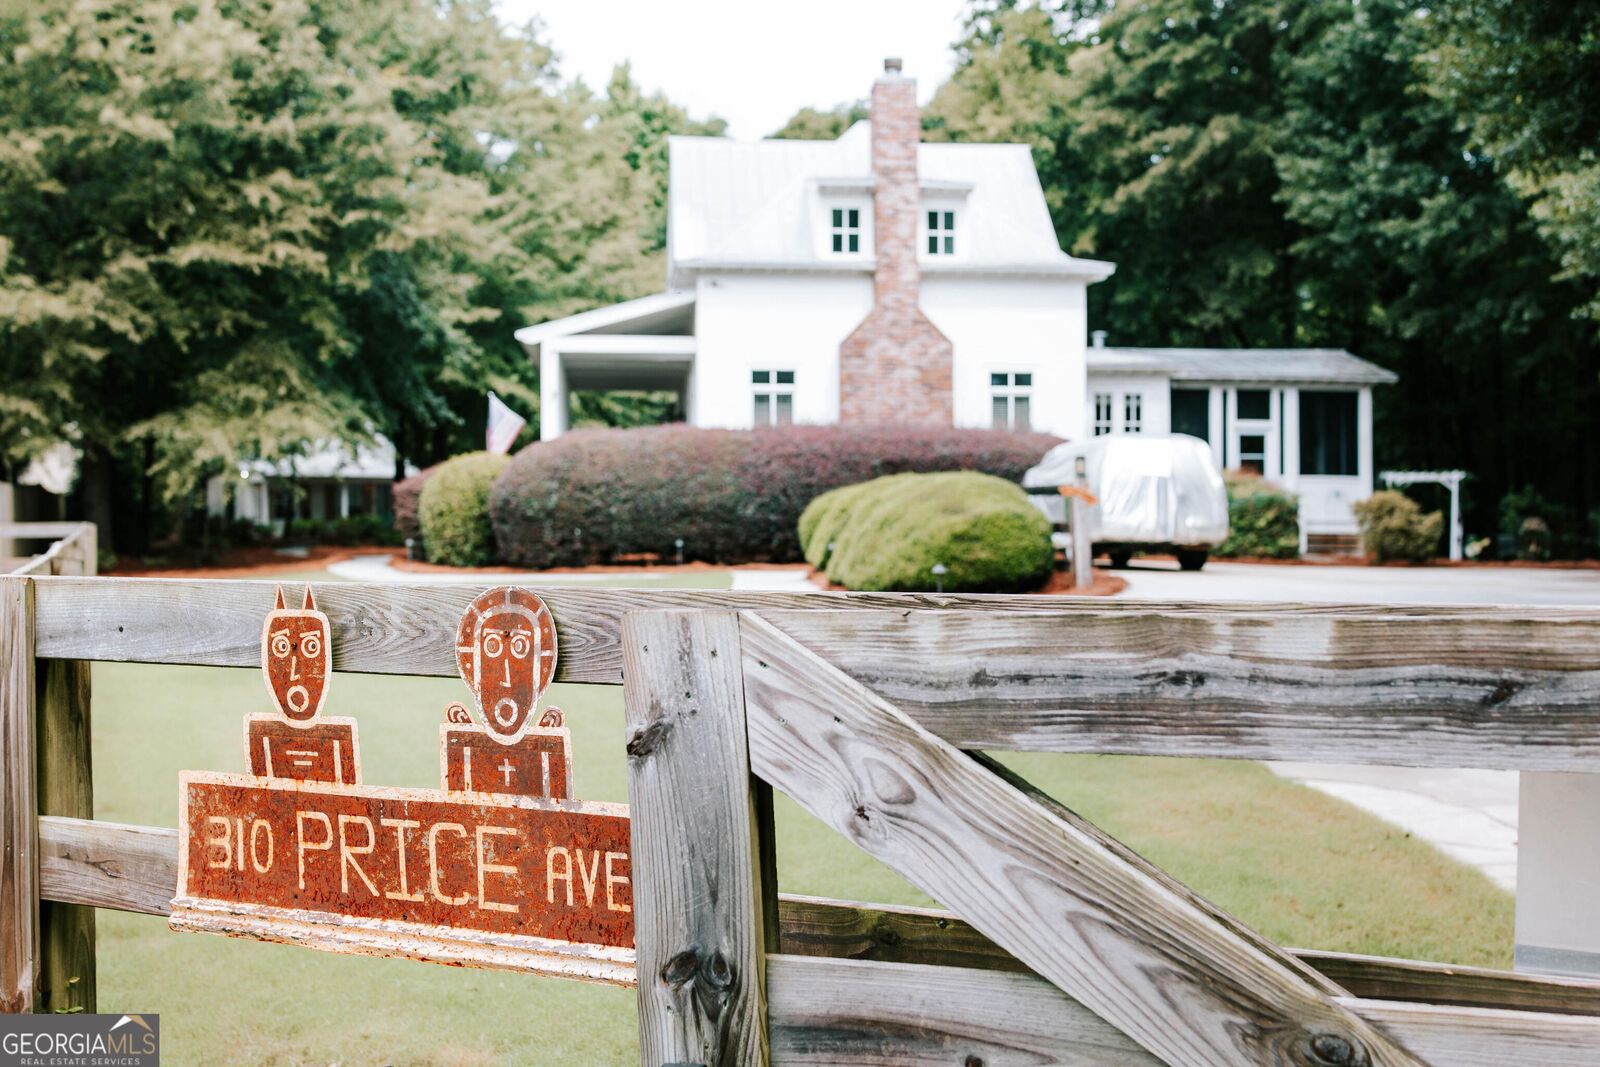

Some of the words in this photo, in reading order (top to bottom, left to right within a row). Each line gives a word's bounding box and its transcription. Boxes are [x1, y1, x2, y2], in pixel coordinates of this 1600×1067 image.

[208, 816, 274, 873] 310
[296, 810, 519, 913] PRICE
[546, 846, 632, 912] AVE
